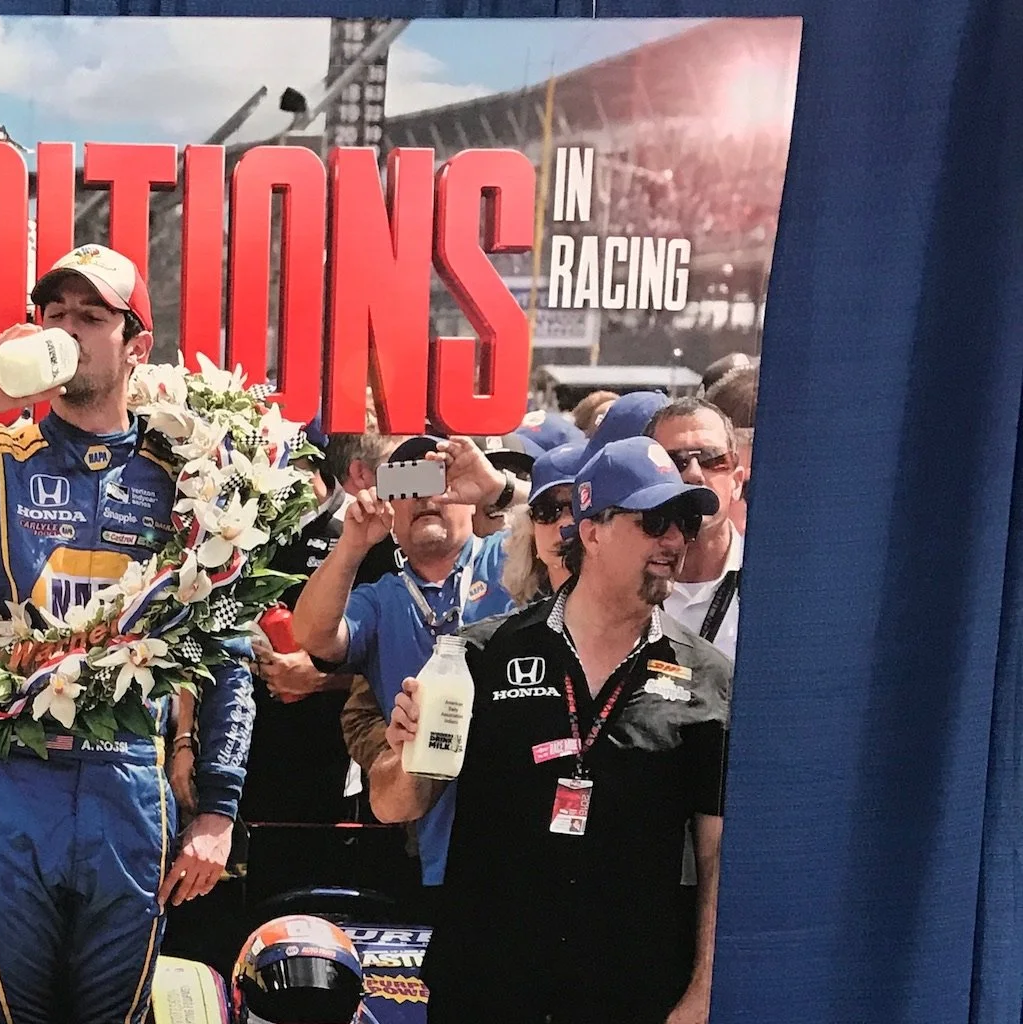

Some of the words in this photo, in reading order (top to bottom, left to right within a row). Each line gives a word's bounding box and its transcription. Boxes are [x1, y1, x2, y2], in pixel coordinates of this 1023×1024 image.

[553, 146, 596, 222] IN
[548, 235, 691, 312] RACING
[17, 504, 88, 523] HONDA
[492, 686, 562, 701] HONDA
[81, 739, 94, 751] A.
[428, 741, 451, 750] MILK
